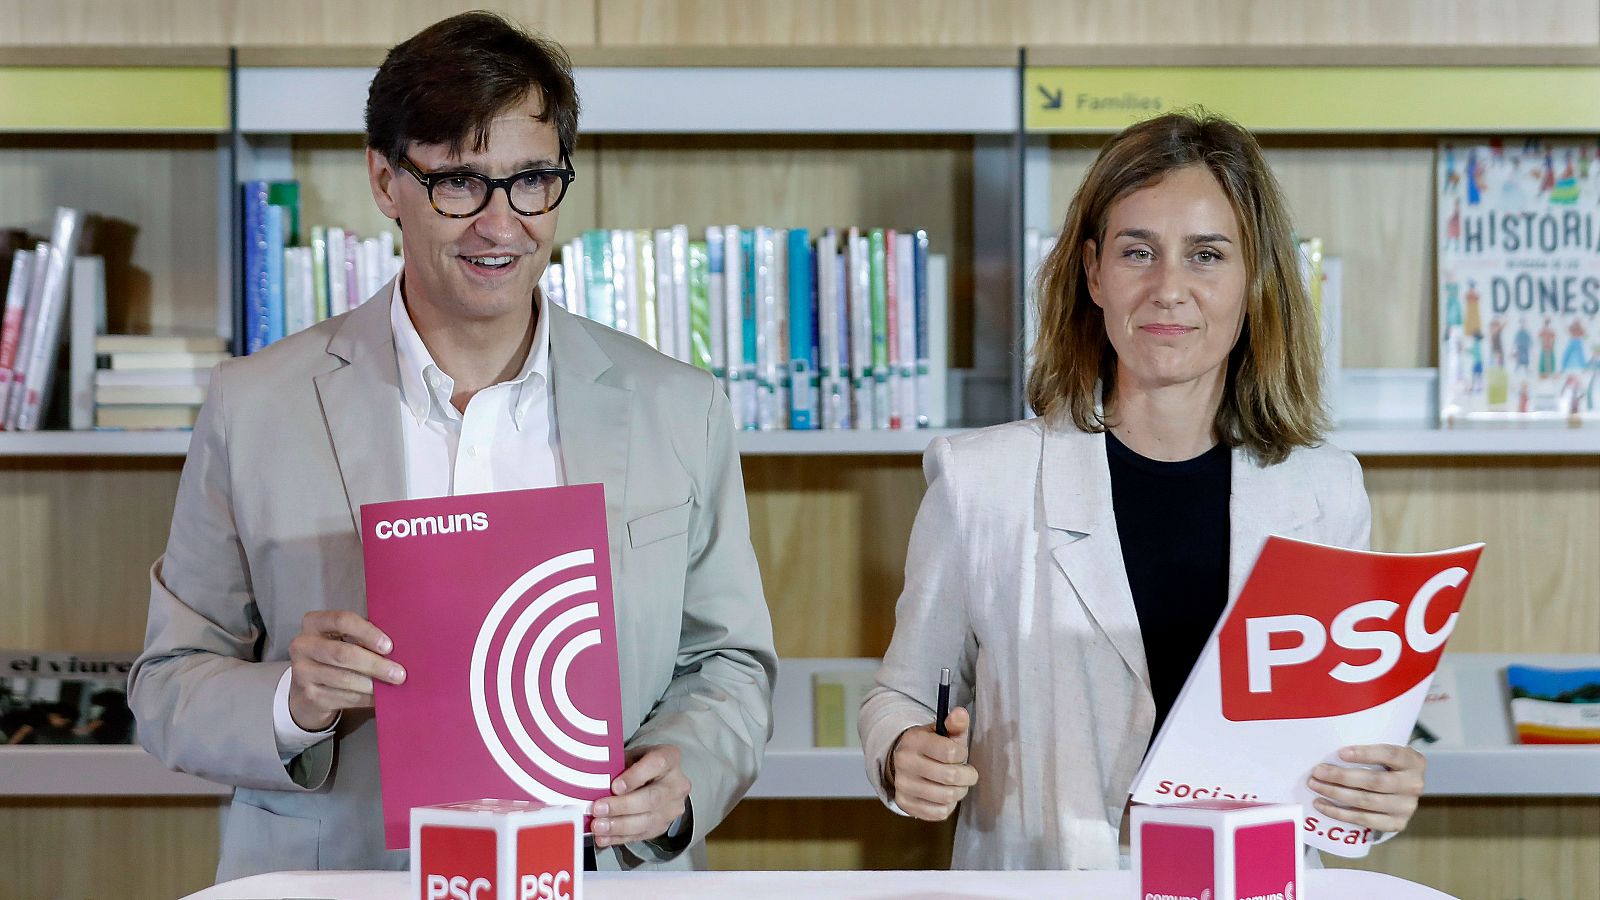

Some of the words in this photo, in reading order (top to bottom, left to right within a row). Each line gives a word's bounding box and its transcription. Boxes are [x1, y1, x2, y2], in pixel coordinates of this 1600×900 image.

[1491, 273, 1600, 316] DONES
[375, 511, 489, 540] comuns
[1246, 566, 1469, 693] PSC
[10, 655, 39, 672] el
[520, 870, 571, 900] PSC
